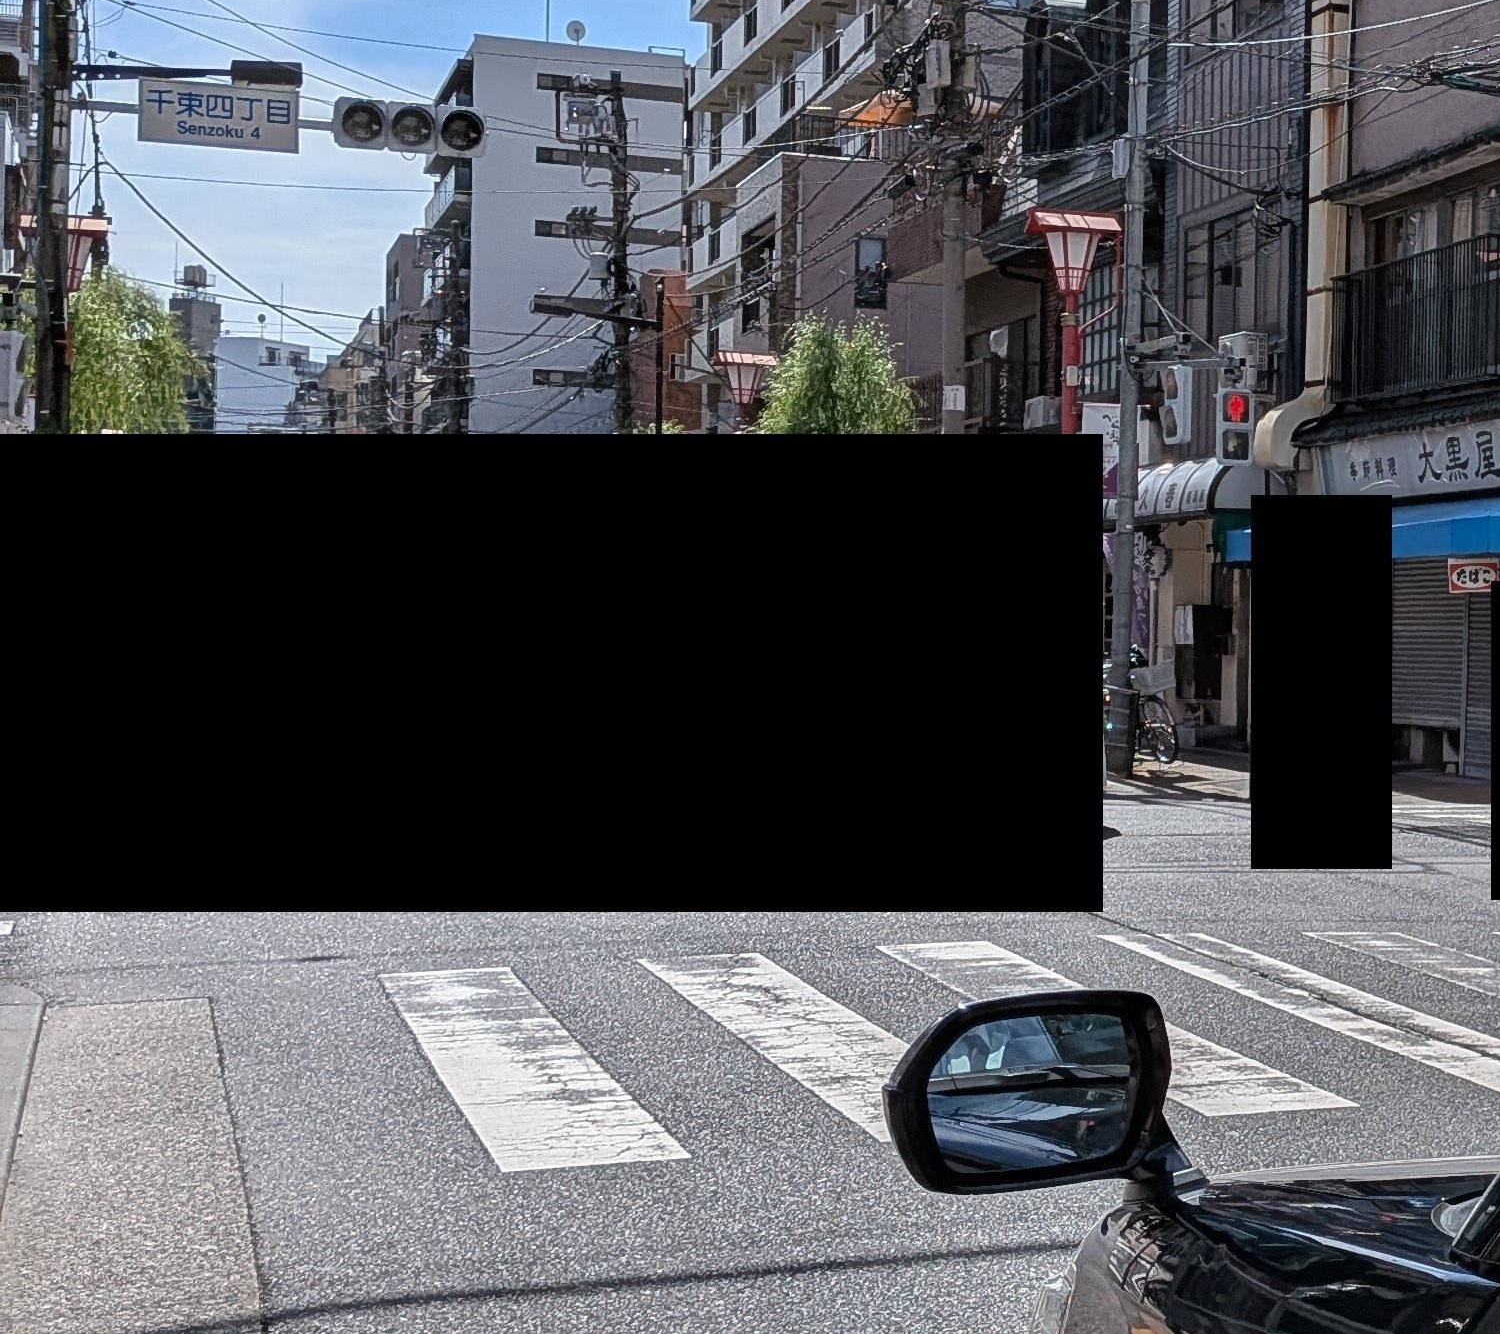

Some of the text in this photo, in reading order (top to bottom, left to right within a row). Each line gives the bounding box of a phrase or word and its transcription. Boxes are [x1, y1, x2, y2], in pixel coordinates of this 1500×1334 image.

[146, 89, 291, 124] 千束四丁目
[177, 120, 261, 139] Senzoku 4
[1456, 567, 1491, 585] たばこ
